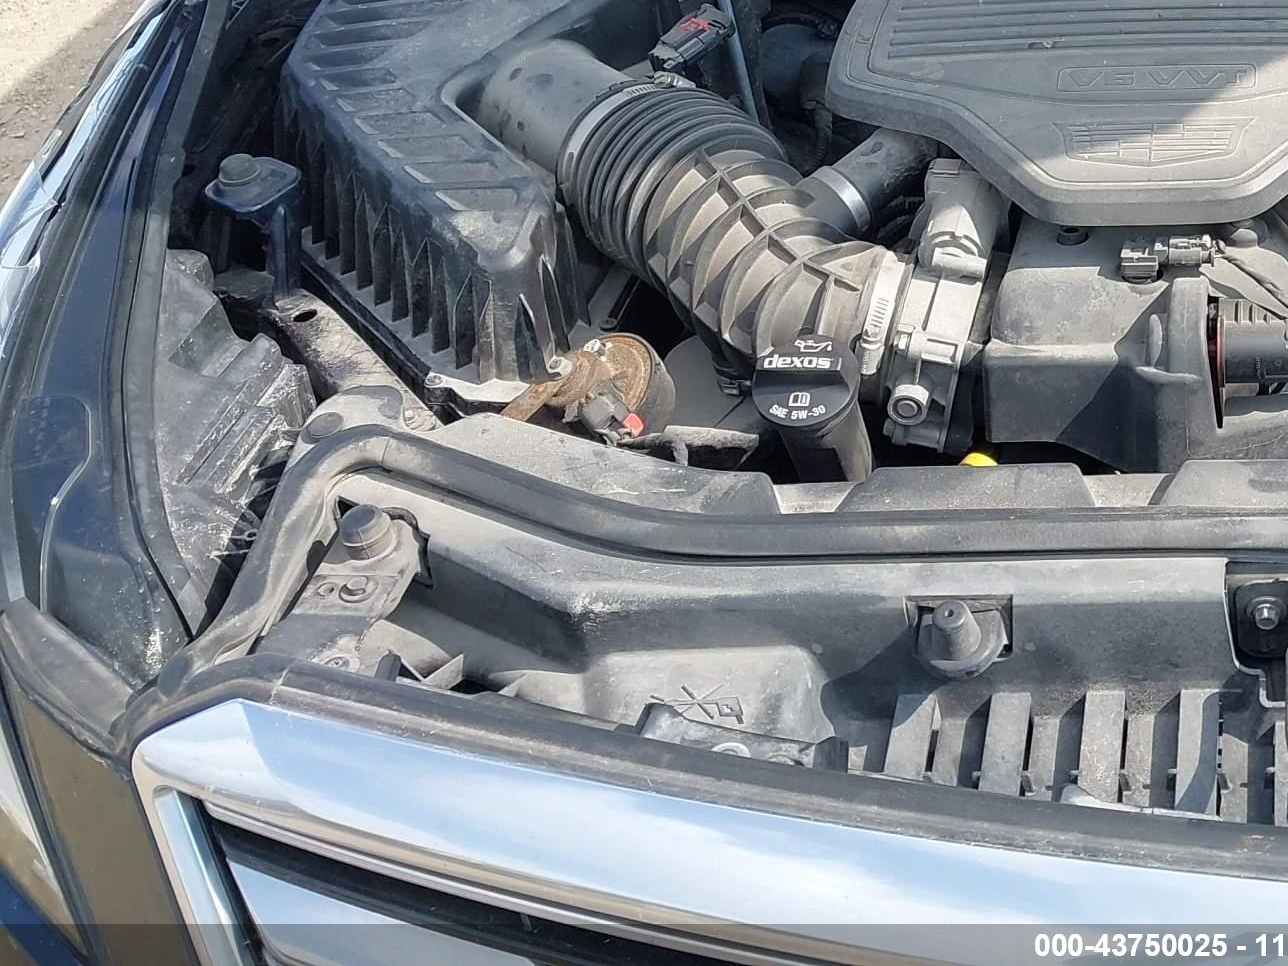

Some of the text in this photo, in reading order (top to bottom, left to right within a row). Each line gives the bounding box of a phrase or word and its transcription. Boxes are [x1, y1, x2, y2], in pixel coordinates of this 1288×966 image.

[1068, 69, 1250, 87] V6 VVT
[763, 354, 834, 369] dexos
[769, 404, 826, 420] SAE 5W-30
